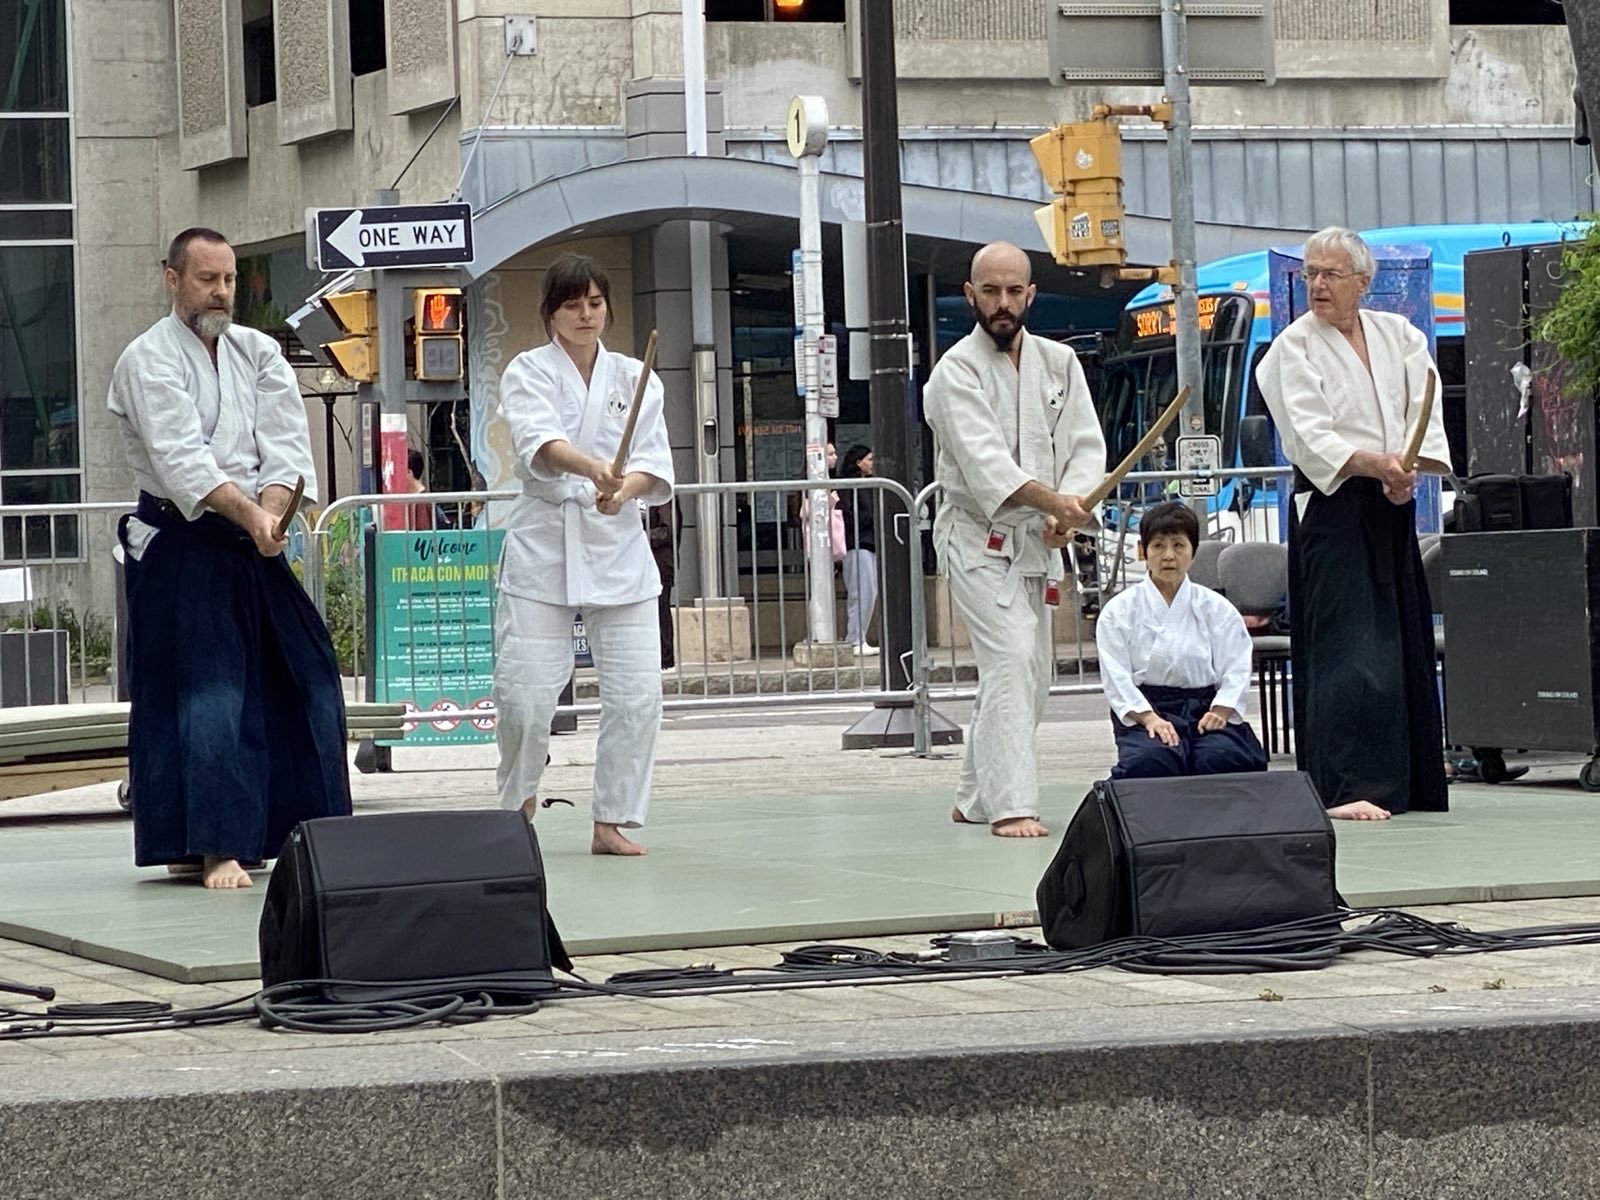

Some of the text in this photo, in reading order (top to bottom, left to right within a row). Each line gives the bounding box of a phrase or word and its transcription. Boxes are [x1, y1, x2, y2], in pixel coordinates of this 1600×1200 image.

[794, 109, 800, 144] 1
[359, 224, 457, 248] ONE WAY
